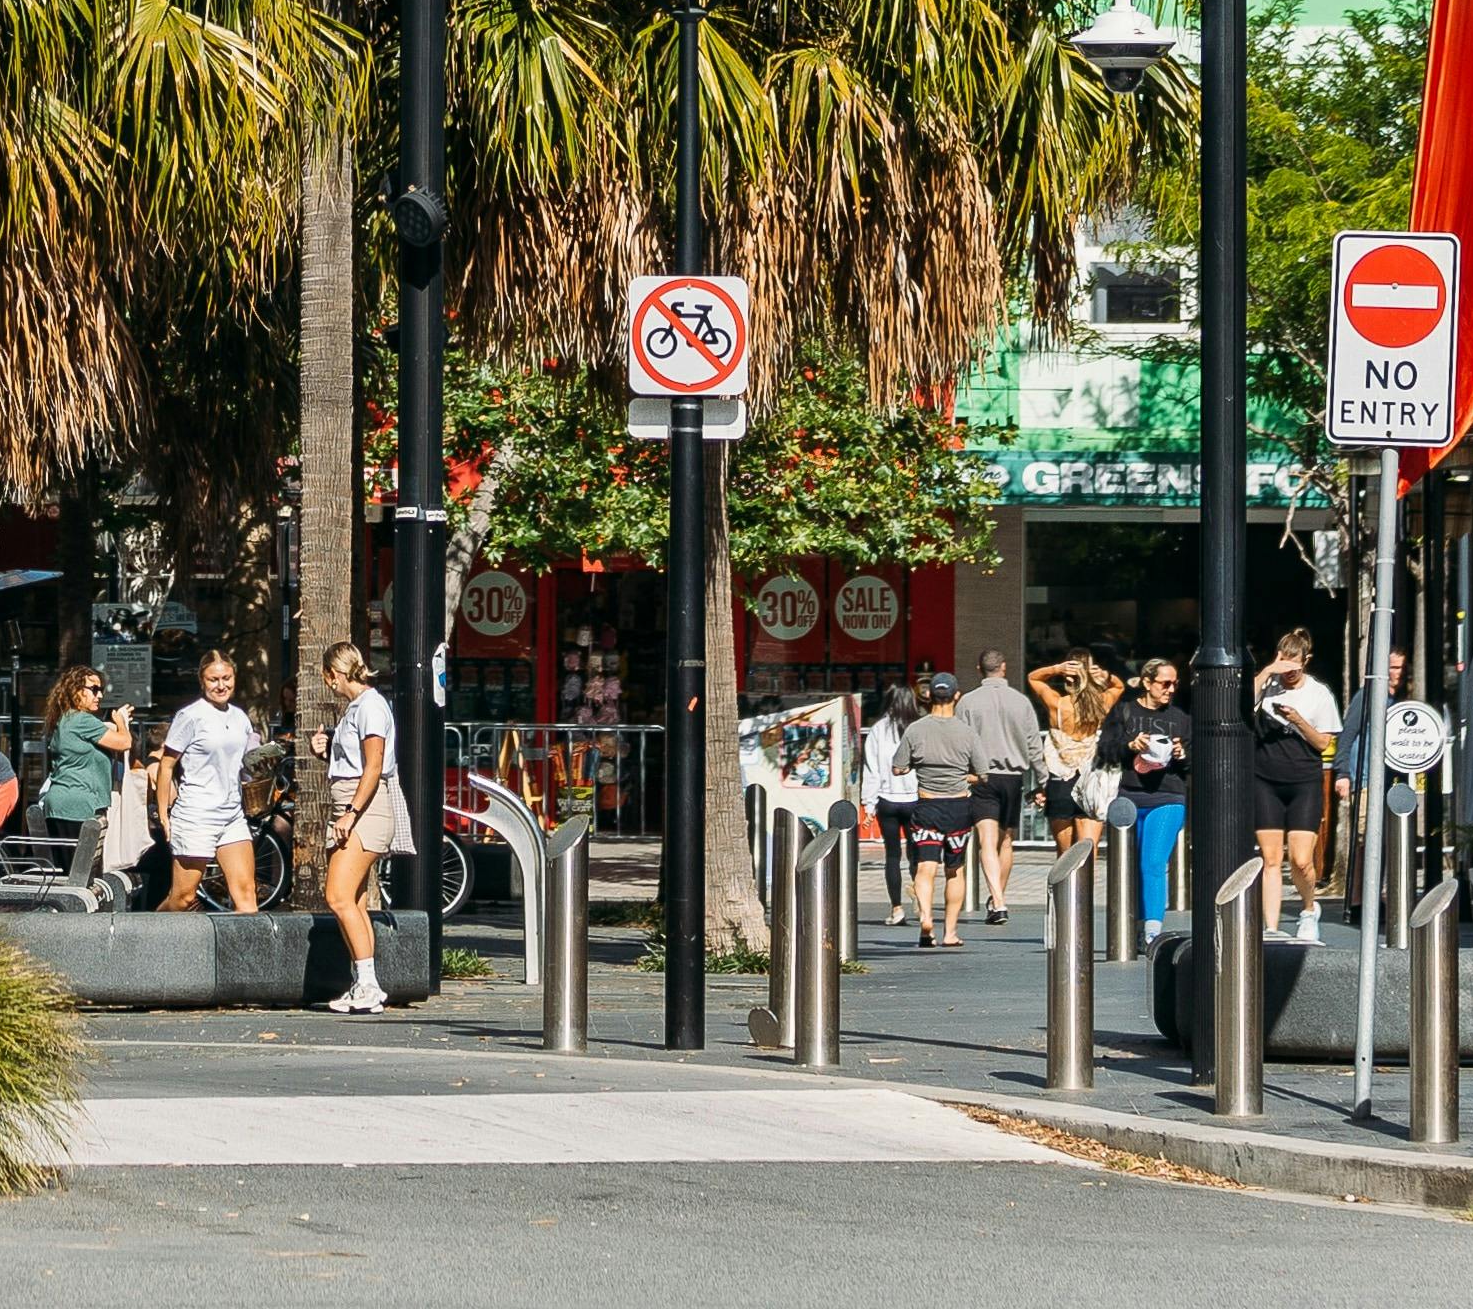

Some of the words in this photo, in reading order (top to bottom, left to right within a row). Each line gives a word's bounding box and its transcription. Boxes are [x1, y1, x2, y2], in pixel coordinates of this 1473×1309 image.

[1365, 359, 1418, 391] NO
[1340, 400, 1440, 427] ENTRY
[842, 586, 892, 613] SALE
[503, 610, 523, 624] OFF
[797, 614, 817, 628] OFF
[842, 614, 869, 630] NOW
[871, 614, 892, 630] ON!
